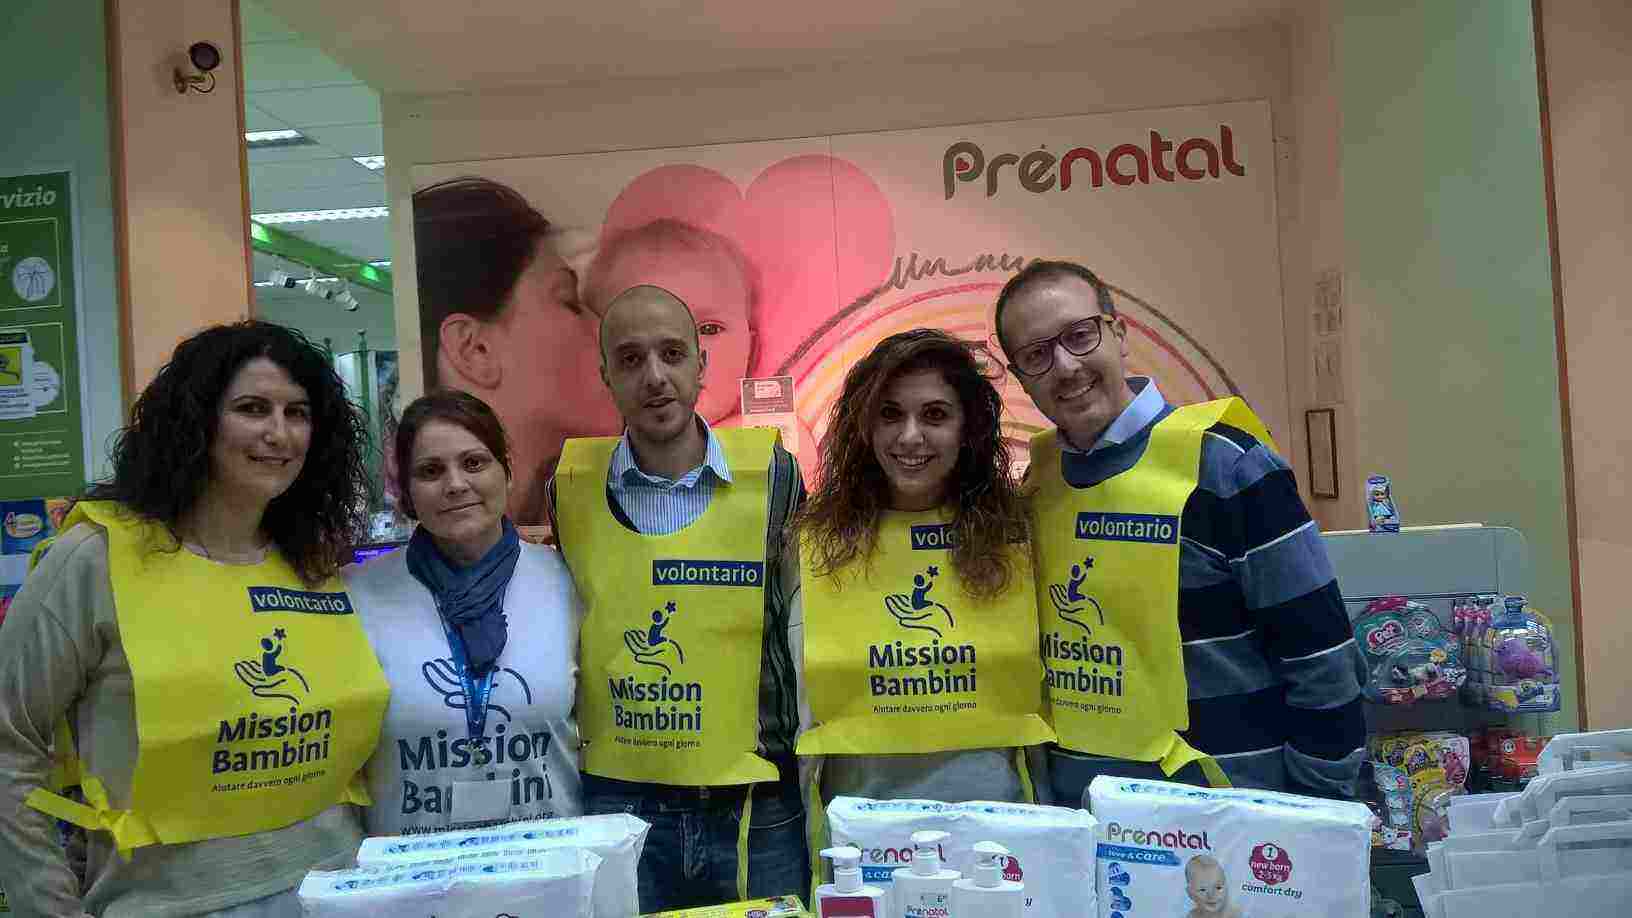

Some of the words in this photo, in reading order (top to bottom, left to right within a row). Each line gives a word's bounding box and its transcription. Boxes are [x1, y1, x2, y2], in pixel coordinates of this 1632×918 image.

[1079, 516, 1173, 540] volontario
[656, 562, 758, 583] volontario
[254, 589, 345, 613] volontario
[868, 639, 976, 669] Mission
[608, 674, 702, 702] Mission
[870, 667, 976, 697] Bambini
[1046, 665, 1123, 697] ambini
[216, 706, 332, 744] Mission
[614, 704, 703, 731] Bambini
[211, 732, 330, 775] Bambini
[398, 724, 552, 771] Mission
[400, 763, 552, 814] Baini
[1241, 883, 1283, 896] comfort
[1283, 886, 1303, 900] dry
